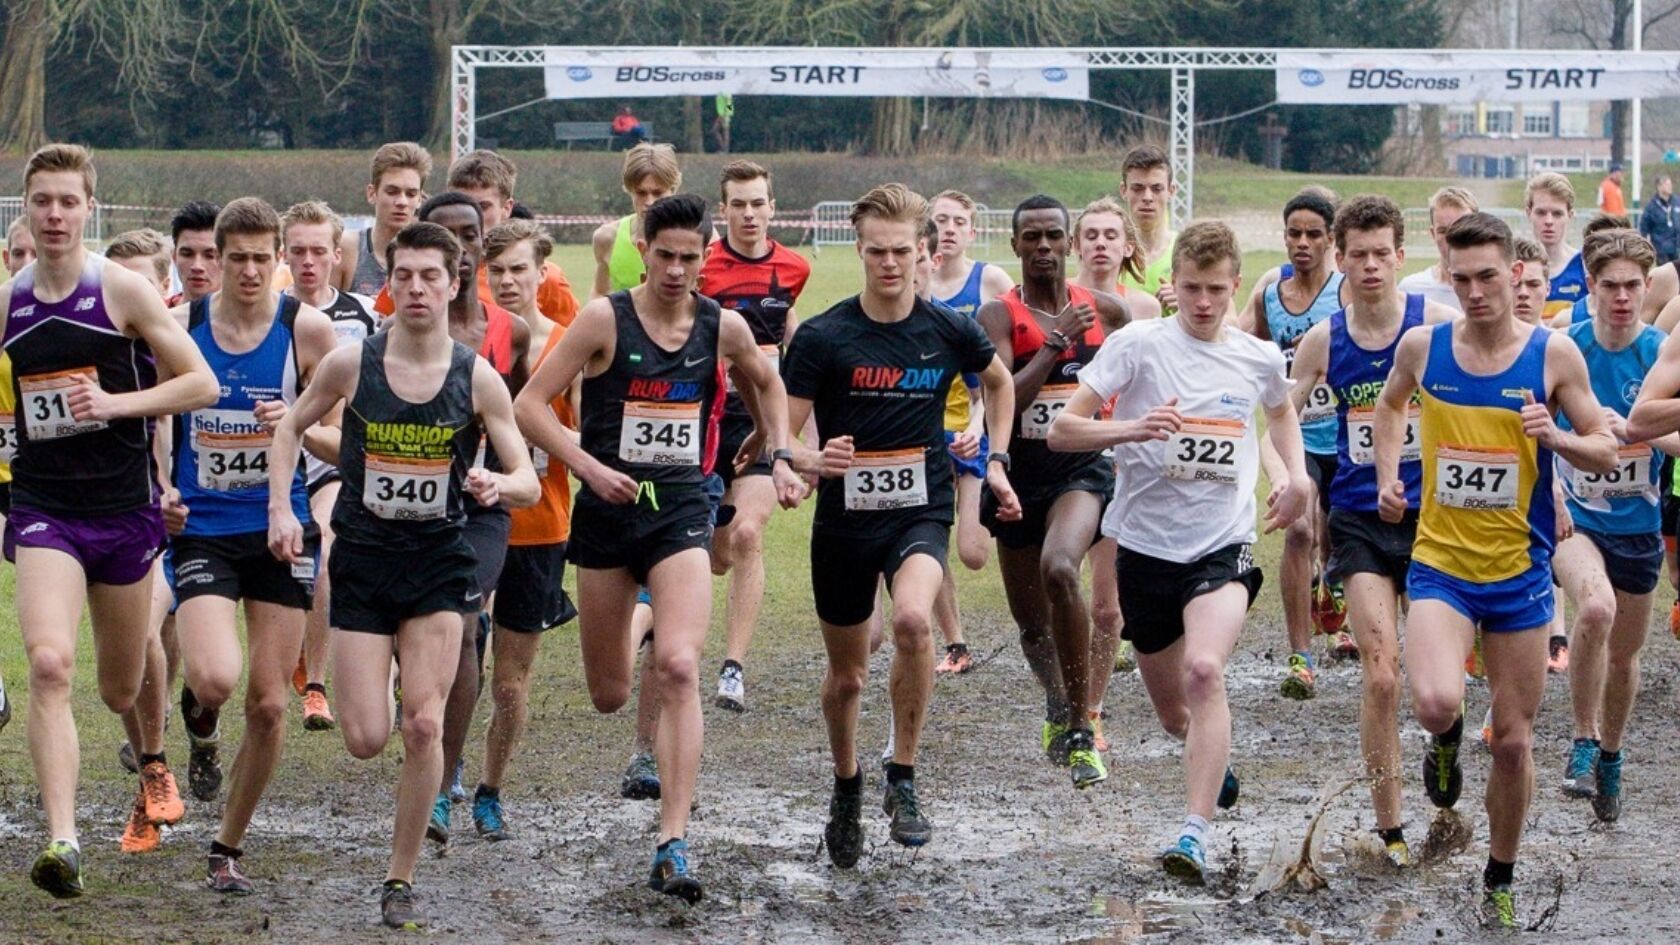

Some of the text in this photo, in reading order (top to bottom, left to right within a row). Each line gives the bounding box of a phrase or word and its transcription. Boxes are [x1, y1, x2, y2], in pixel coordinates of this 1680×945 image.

[615, 65, 866, 83] BOScross START
[1347, 69, 1460, 90] BOScross
[1505, 68, 1606, 89] START
[1341, 381, 1386, 399] LOPE
[33, 393, 65, 420] 31
[366, 421, 454, 444] RUNSHOP
[634, 421, 691, 448] 345
[1358, 423, 1415, 448] 33
[209, 451, 268, 475] 344
[1177, 437, 1235, 465] 322
[376, 476, 437, 504] 340
[857, 468, 915, 494] 338
[1445, 464, 1508, 492] 347
